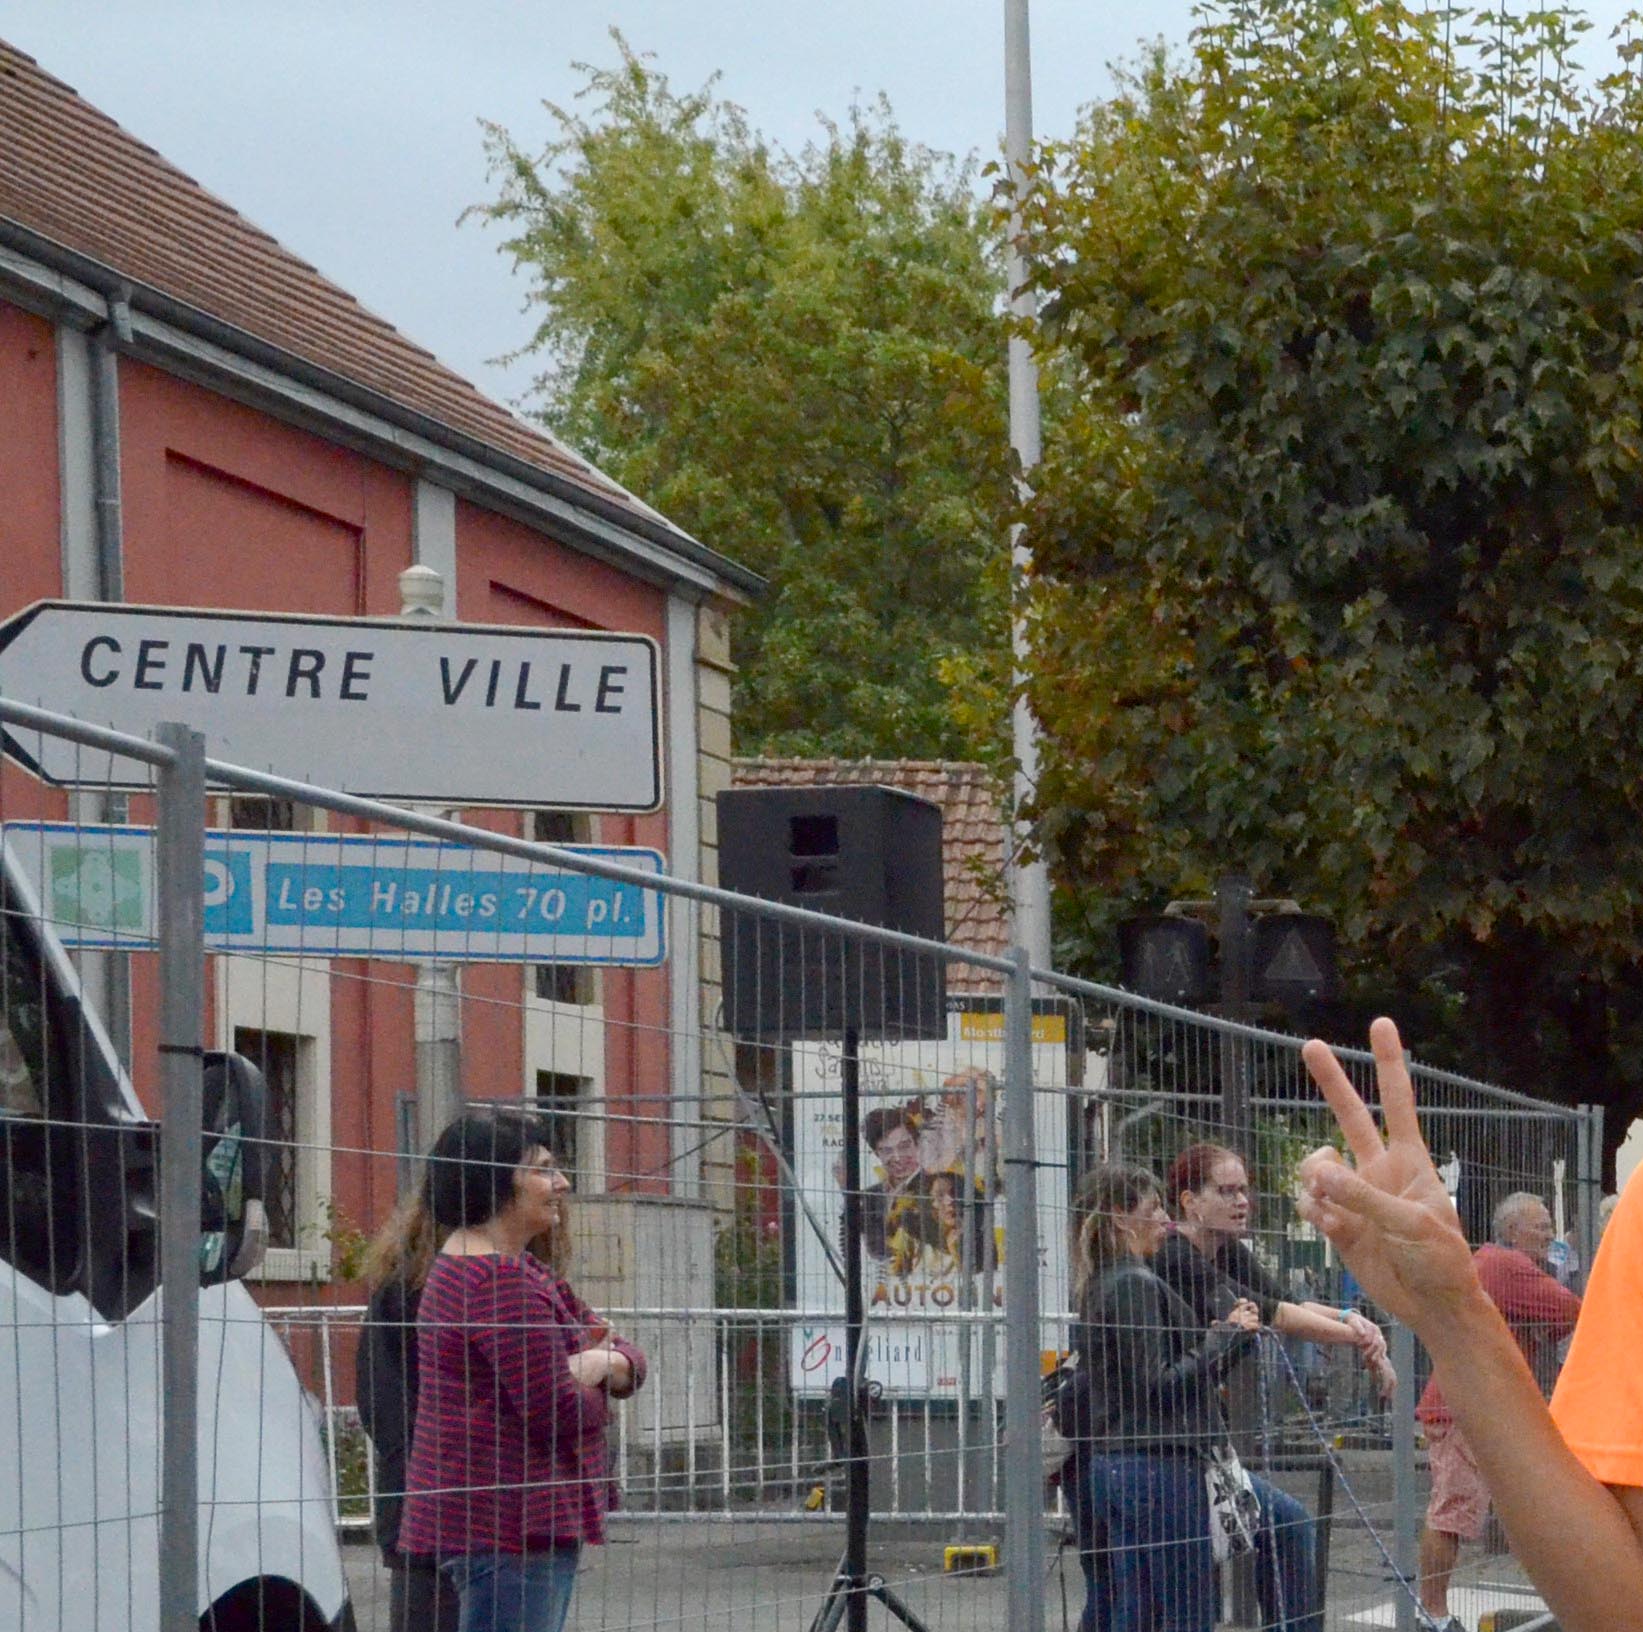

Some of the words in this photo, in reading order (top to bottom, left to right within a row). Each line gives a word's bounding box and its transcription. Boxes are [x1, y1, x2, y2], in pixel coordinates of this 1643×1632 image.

[81, 635, 374, 702] CENTRE
[440, 656, 627, 713] VILLE
[279, 877, 346, 912] Les
[369, 881, 498, 917] Halles
[516, 888, 566, 922] 70
[586, 893, 631, 930] pl.
